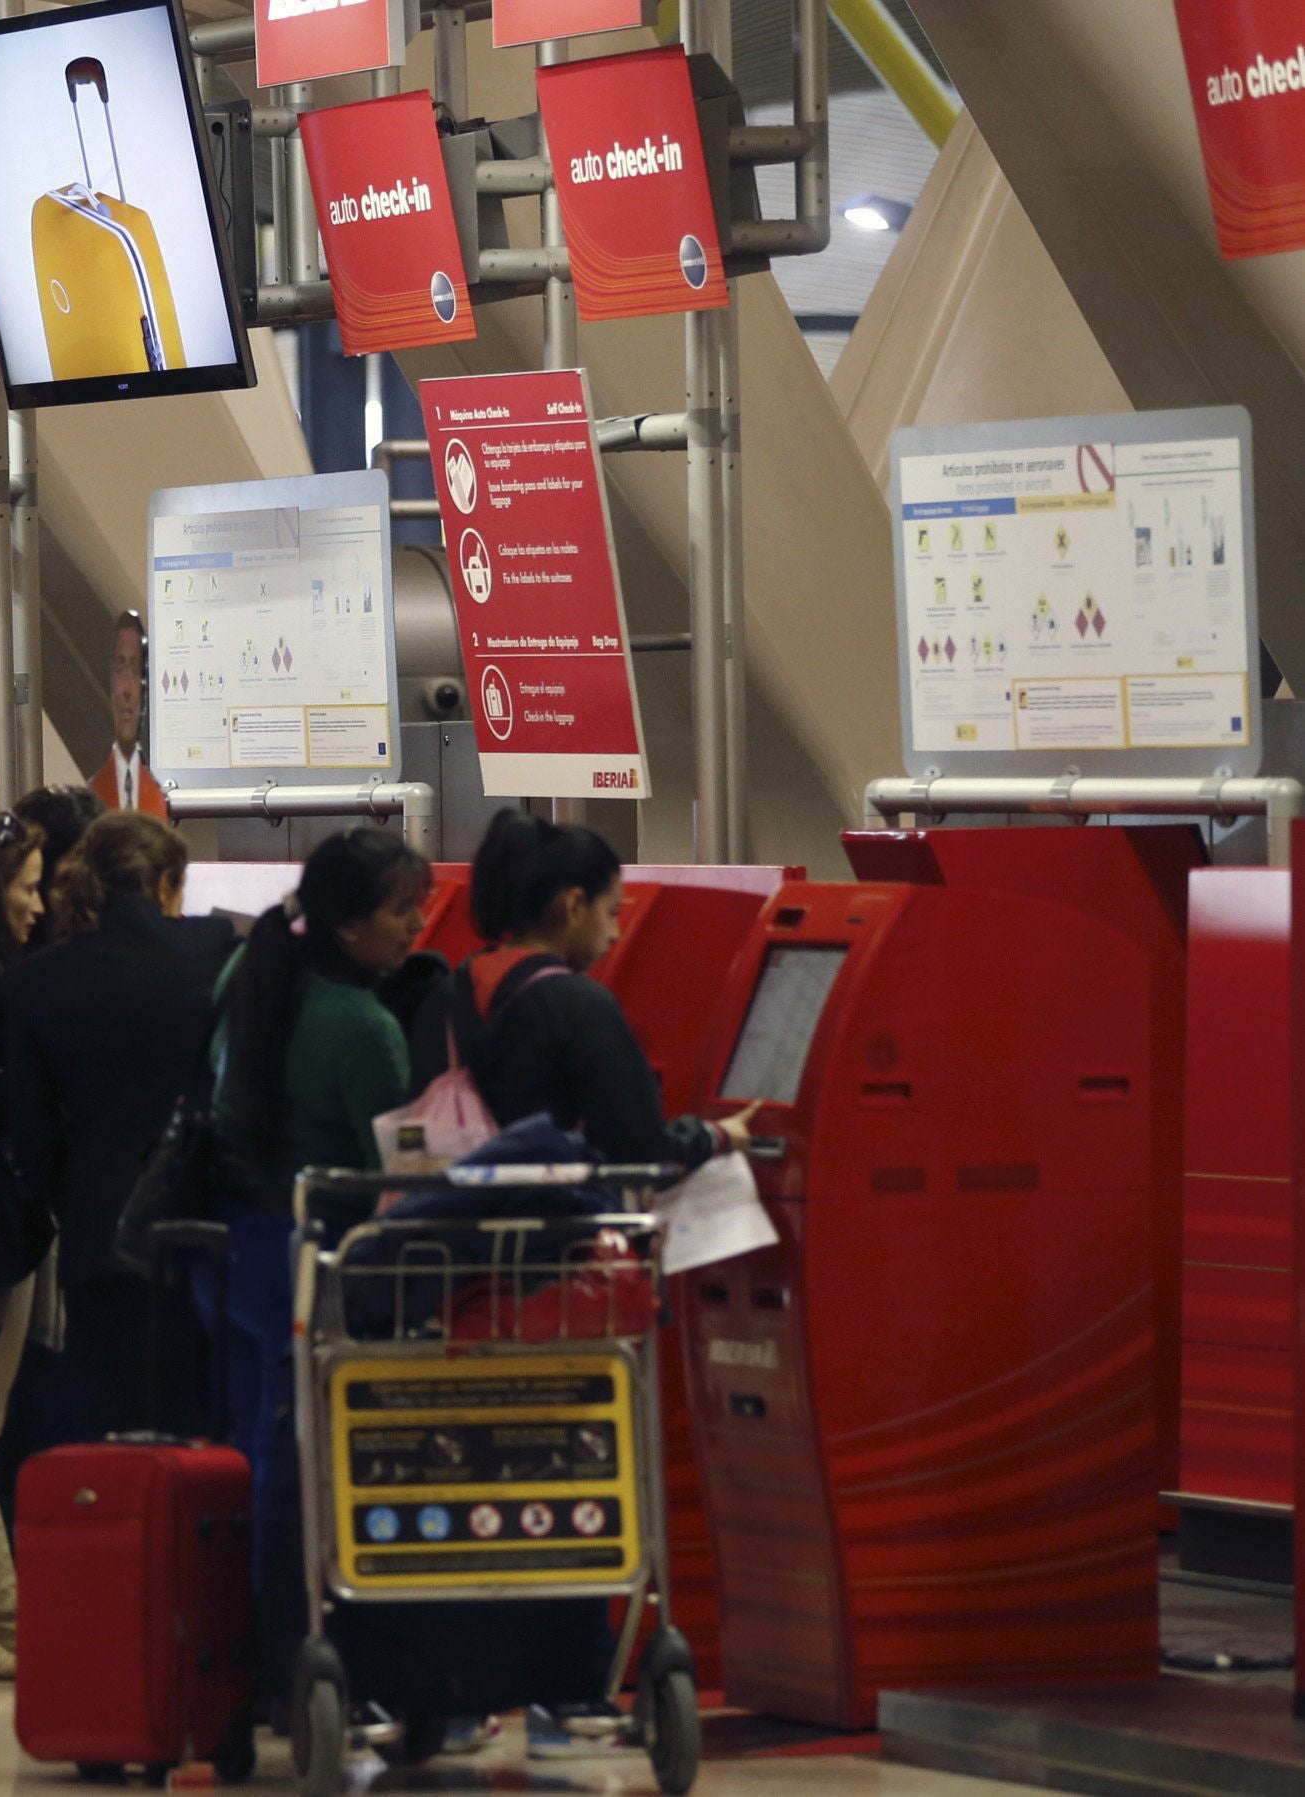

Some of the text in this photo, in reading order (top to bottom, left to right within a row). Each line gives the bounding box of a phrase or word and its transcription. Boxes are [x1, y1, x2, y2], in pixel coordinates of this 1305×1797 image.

[1207, 65, 1244, 106] auto
[570, 135, 683, 184] auto check-in
[329, 176, 432, 226] auto check-in
[435, 406, 442, 421] 1
[474, 408, 486, 420] Auto
[547, 402, 557, 415] Self
[536, 478, 547, 491] and
[561, 476, 571, 489] for
[571, 479, 584, 492] your
[490, 494, 511, 509] luggage
[503, 572, 511, 585] Fix
[511, 571, 520, 585] the
[535, 573, 541, 583] to
[541, 570, 550, 583] the
[472, 632, 479, 647] 2
[519, 636, 527, 648] de
[527, 636, 548, 650] Entrega
[548, 635, 555, 647] de
[556, 635, 579, 650] Equipaje
[592, 635, 618, 650] Bag Drop
[544, 709, 552, 722] the
[593, 771, 630, 789] IBERIA
